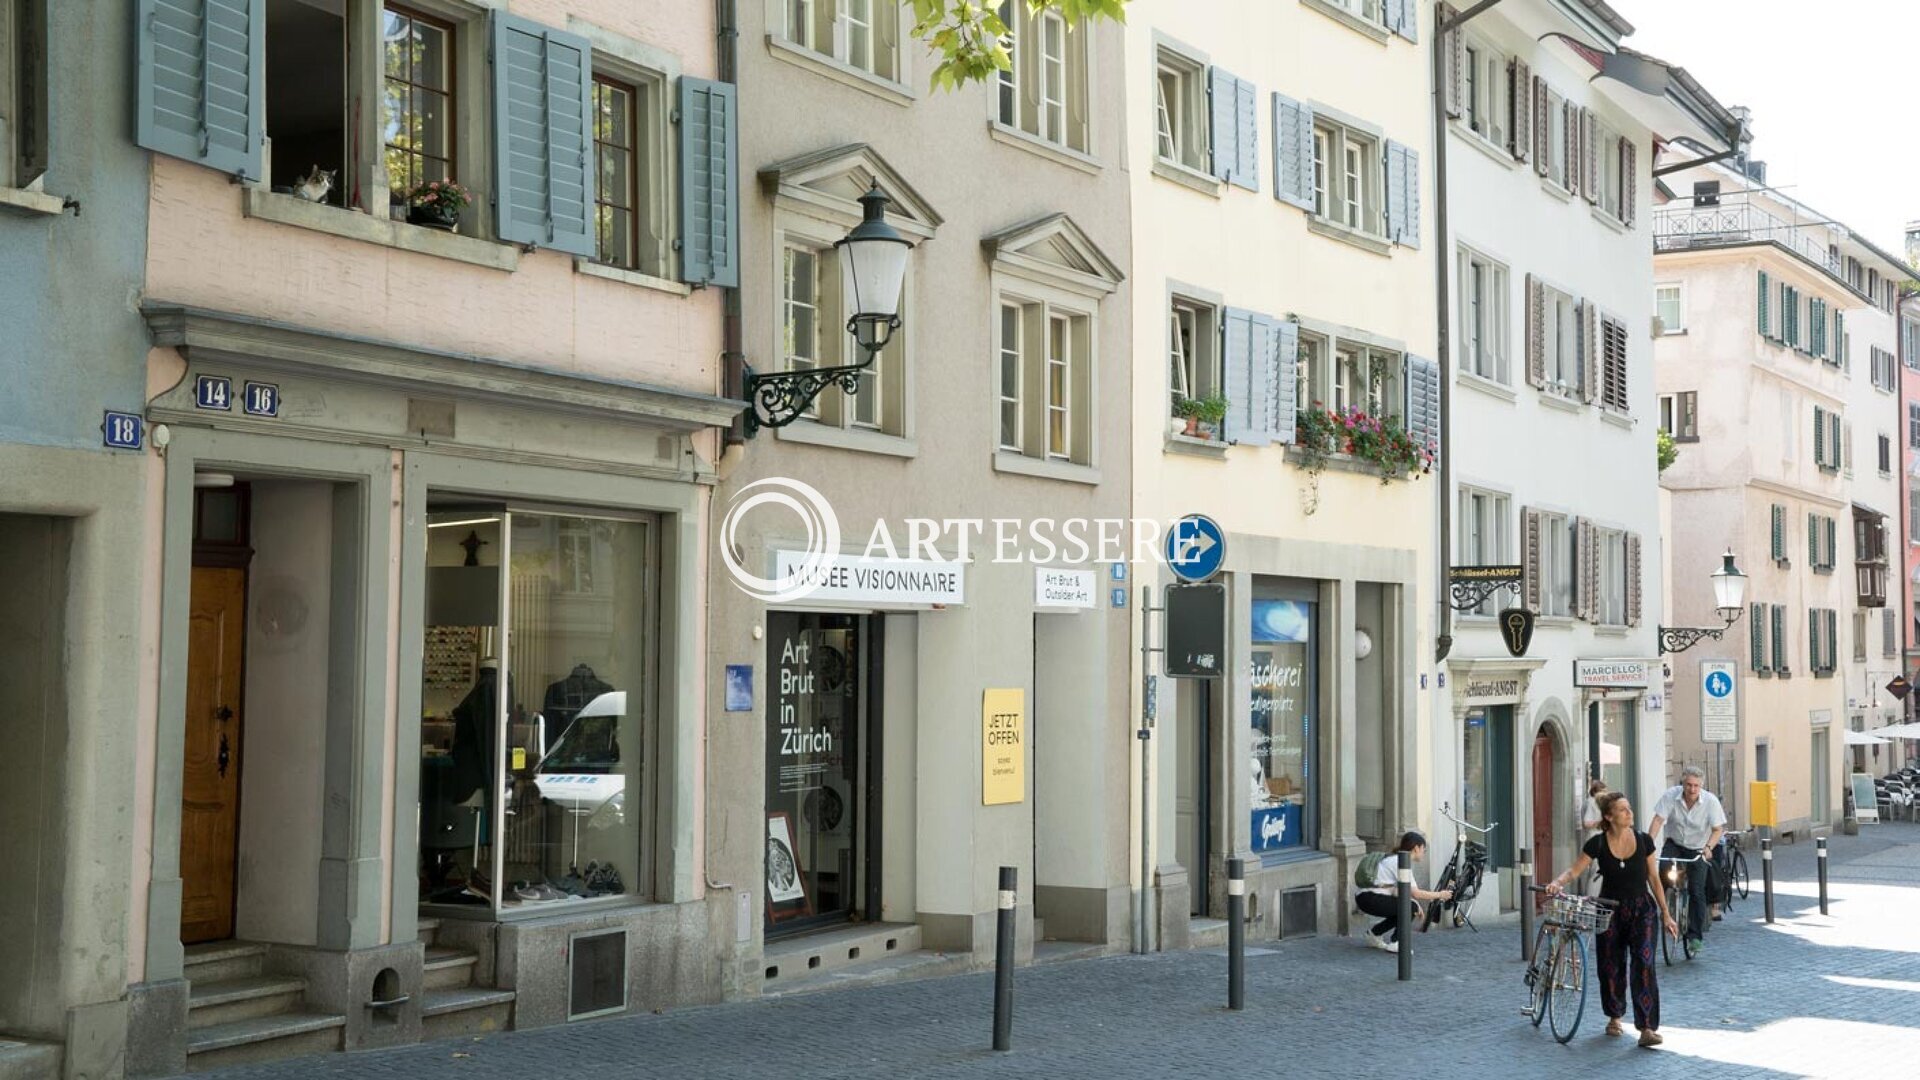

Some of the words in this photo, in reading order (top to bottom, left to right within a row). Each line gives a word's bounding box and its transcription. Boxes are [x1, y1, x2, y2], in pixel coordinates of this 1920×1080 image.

[206, 380, 226, 406] 14
[254, 387, 272, 412] 16
[113, 417, 134, 443] 18
[855, 567, 956, 593] VISIONNAIRE
[1045, 573, 1057, 586] Art
[1059, 574, 1074, 587] Brut
[1045, 588, 1075, 601] Outsider
[1076, 590, 1088, 602] Art
[781, 637, 809, 664] Art
[780, 668, 815, 695] Brut
[1583, 664, 1643, 676] MARCELLOS
[1583, 674, 1610, 683] TRAVEL
[1612, 673, 1645, 682] SERVICE
[780, 698, 795, 724] in
[989, 713, 1019, 728] JETZT
[780, 725, 832, 755] Zürich
[988, 730, 1020, 746] OFFEN
